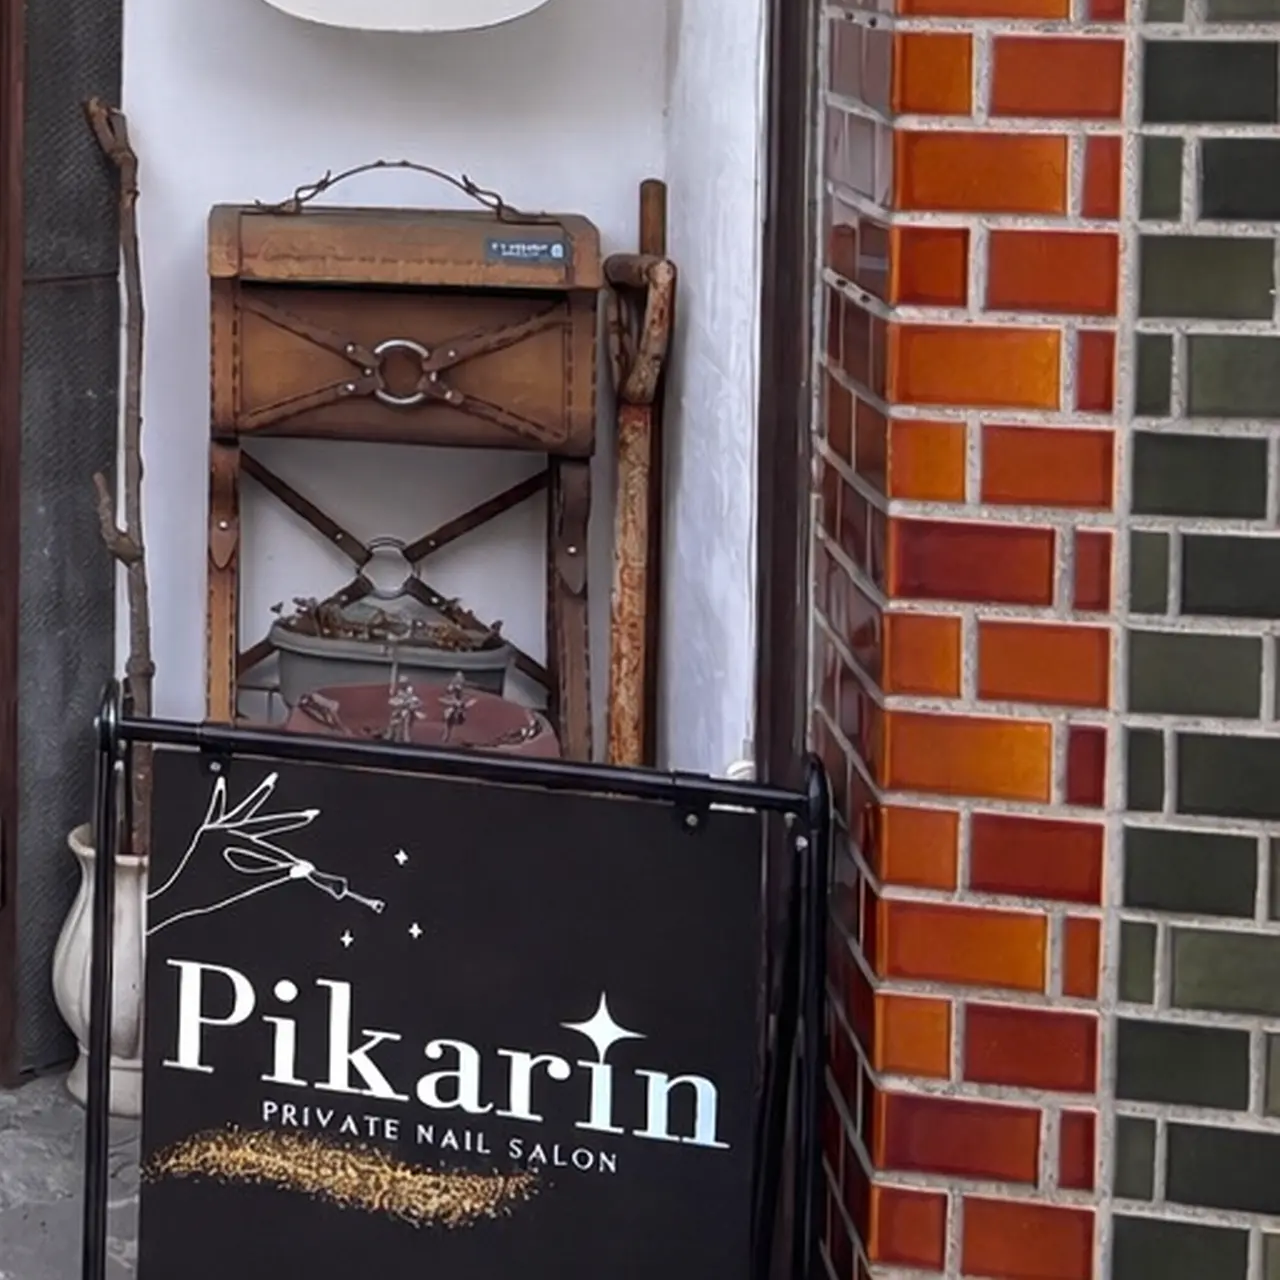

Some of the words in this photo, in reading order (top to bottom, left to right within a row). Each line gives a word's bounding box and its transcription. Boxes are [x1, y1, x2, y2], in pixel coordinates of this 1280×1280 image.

[162, 959, 730, 1149] Pikarin
[262, 1100, 400, 1140] PRIVATE
[416, 1124, 492, 1155] NAIL
[509, 1138, 619, 1174] SALON
